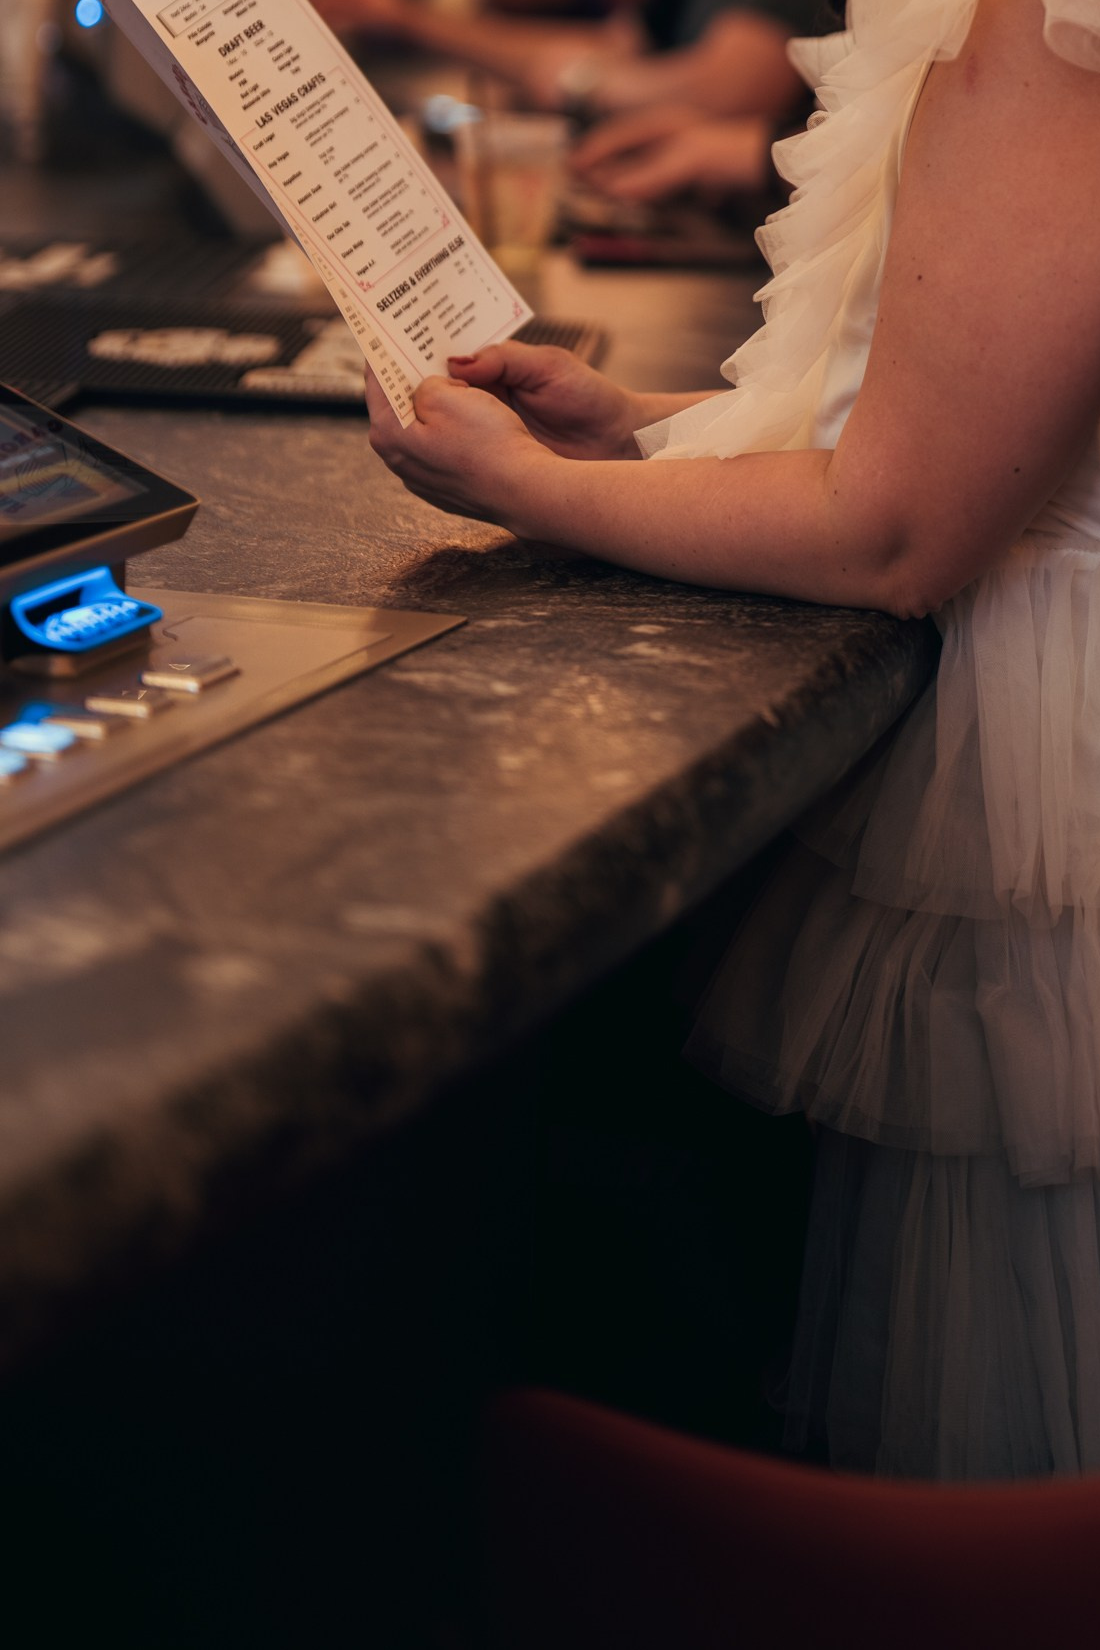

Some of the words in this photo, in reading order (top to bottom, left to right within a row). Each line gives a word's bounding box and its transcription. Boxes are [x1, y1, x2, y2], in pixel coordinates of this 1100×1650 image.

[218, 33, 245, 58] DRAFT
[243, 20, 265, 39] BEER
[255, 112, 273, 129] LAS
[271, 92, 299, 116] VEGAS
[297, 72, 326, 97] CRAFTS
[376, 281, 411, 312] SELTZERS
[407, 275, 418, 287] &
[414, 248, 450, 282] EVERYTHING
[447, 235, 465, 254] ELSE
